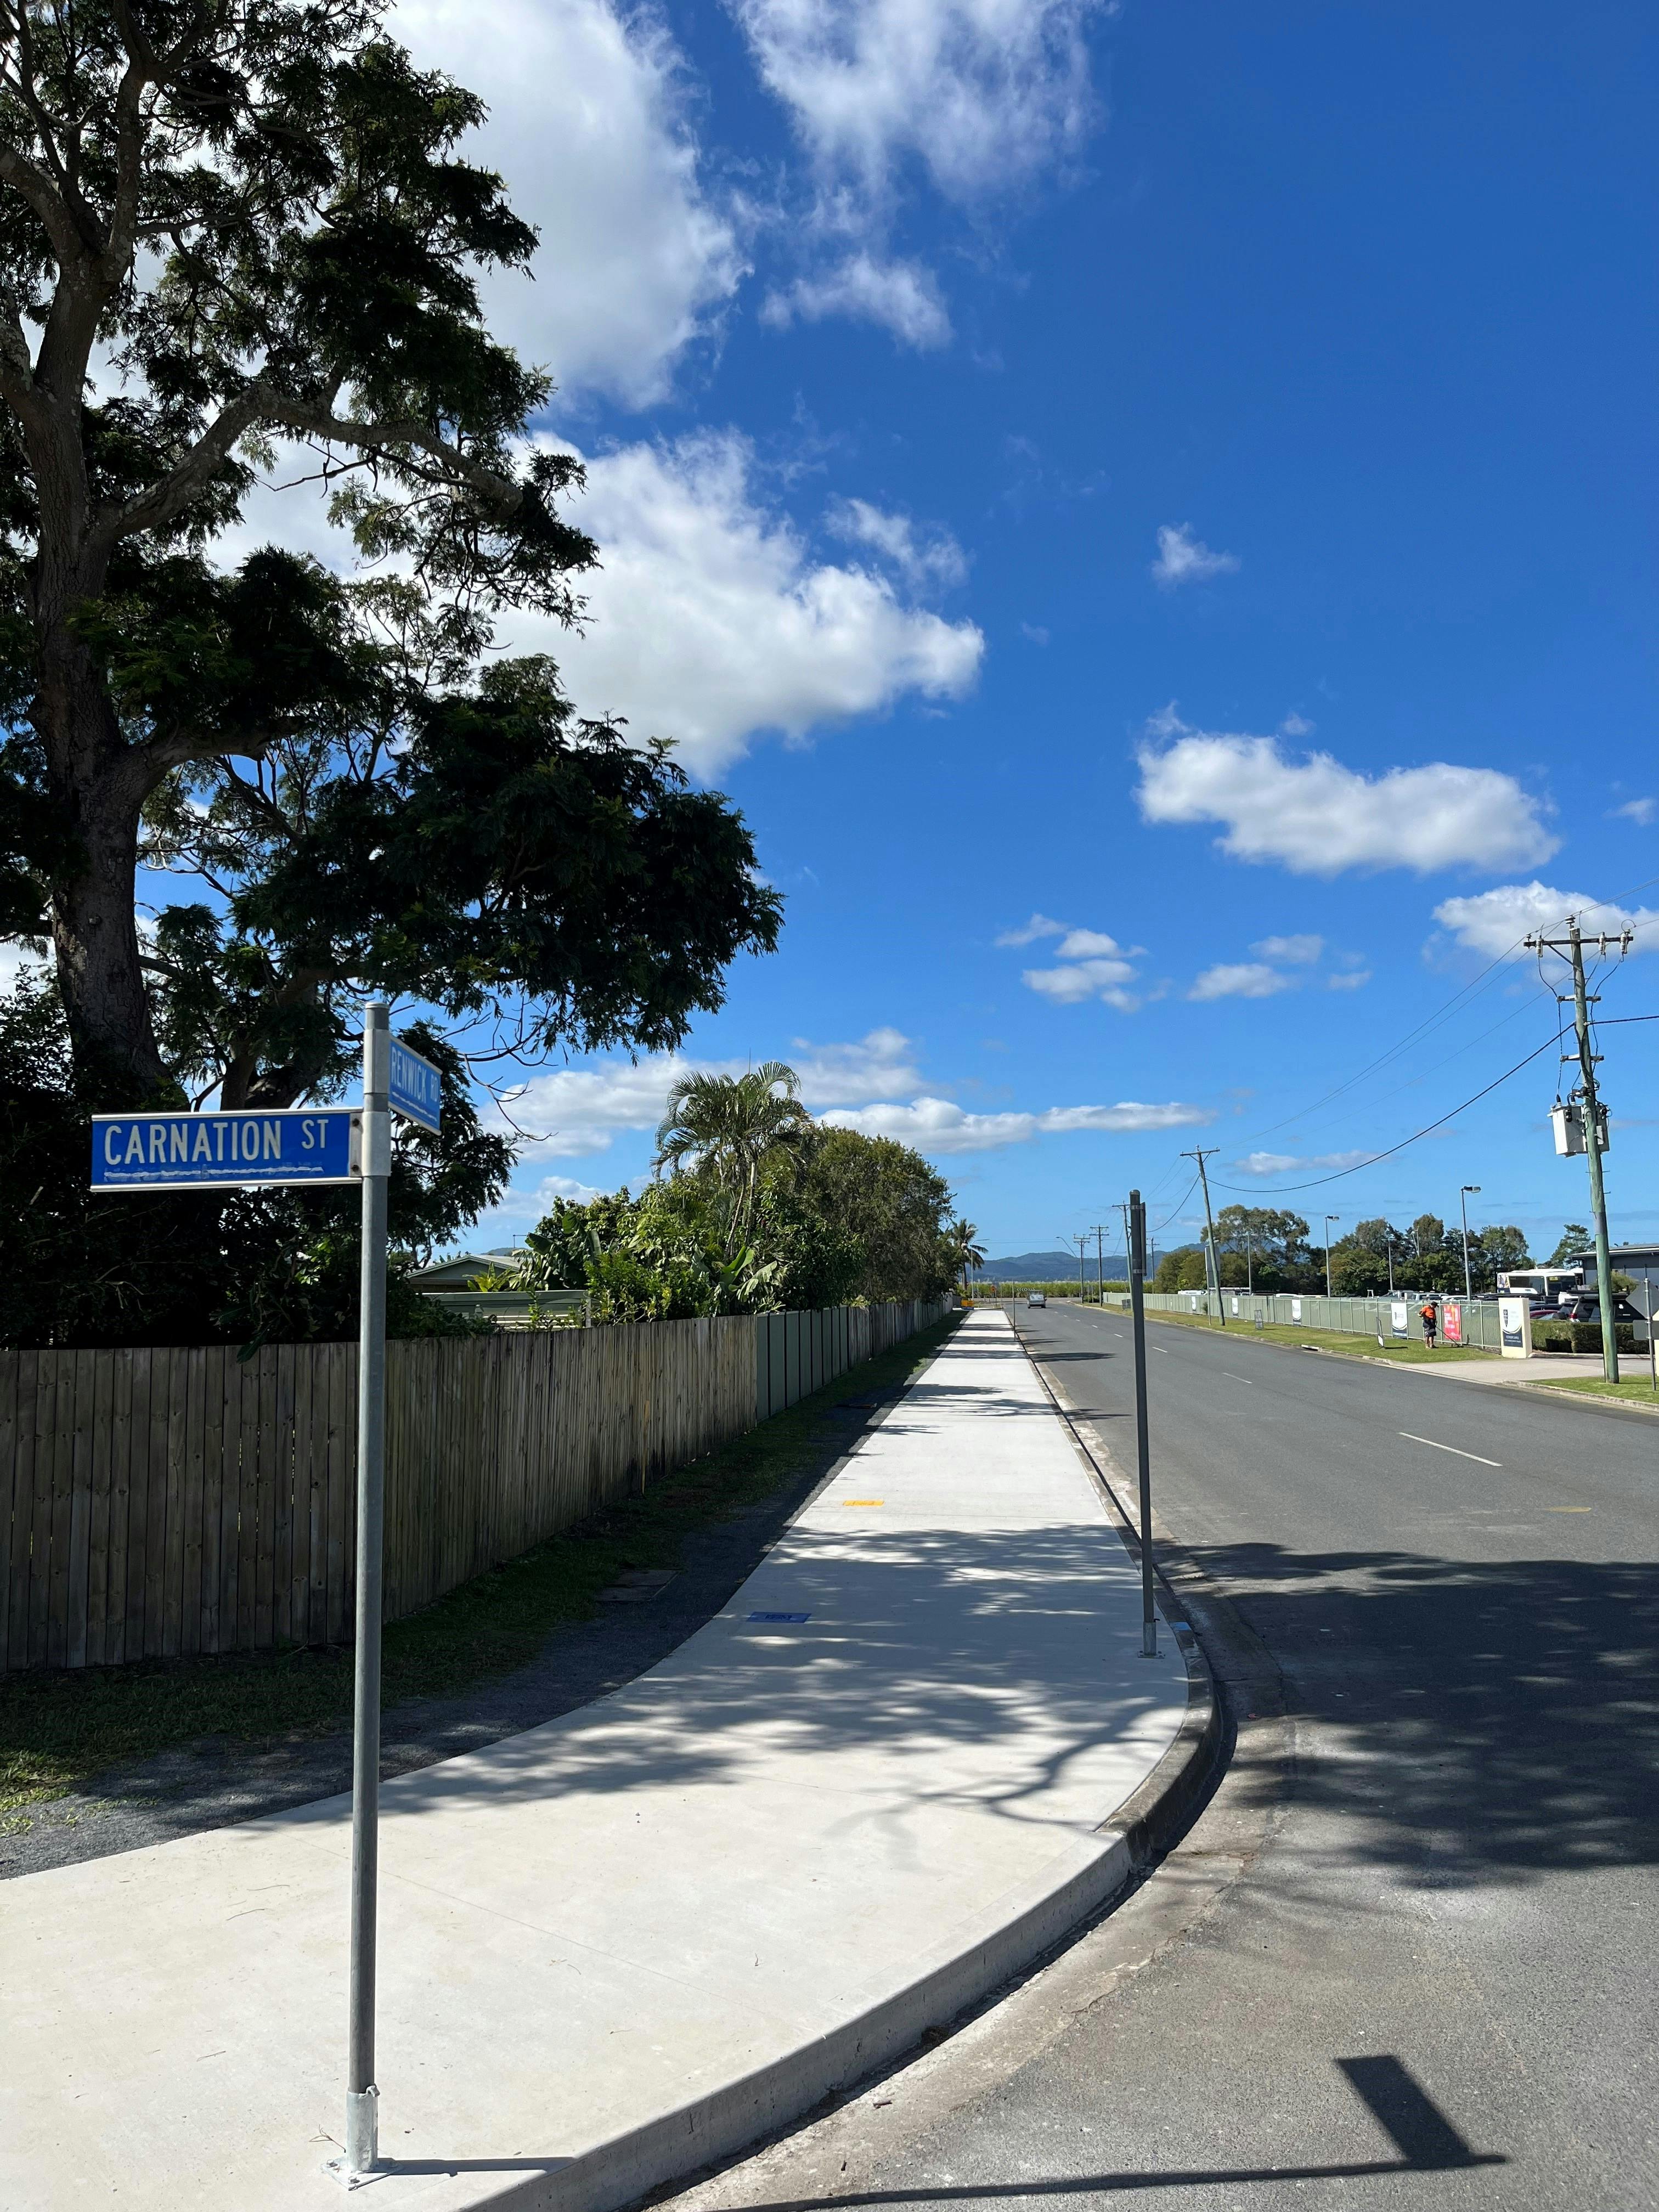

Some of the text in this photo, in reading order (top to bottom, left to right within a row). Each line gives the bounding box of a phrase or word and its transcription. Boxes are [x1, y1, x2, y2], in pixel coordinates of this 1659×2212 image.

[391, 1046, 438, 1103] RENWICK RD
[105, 1119, 329, 1165] CARNATION ST
